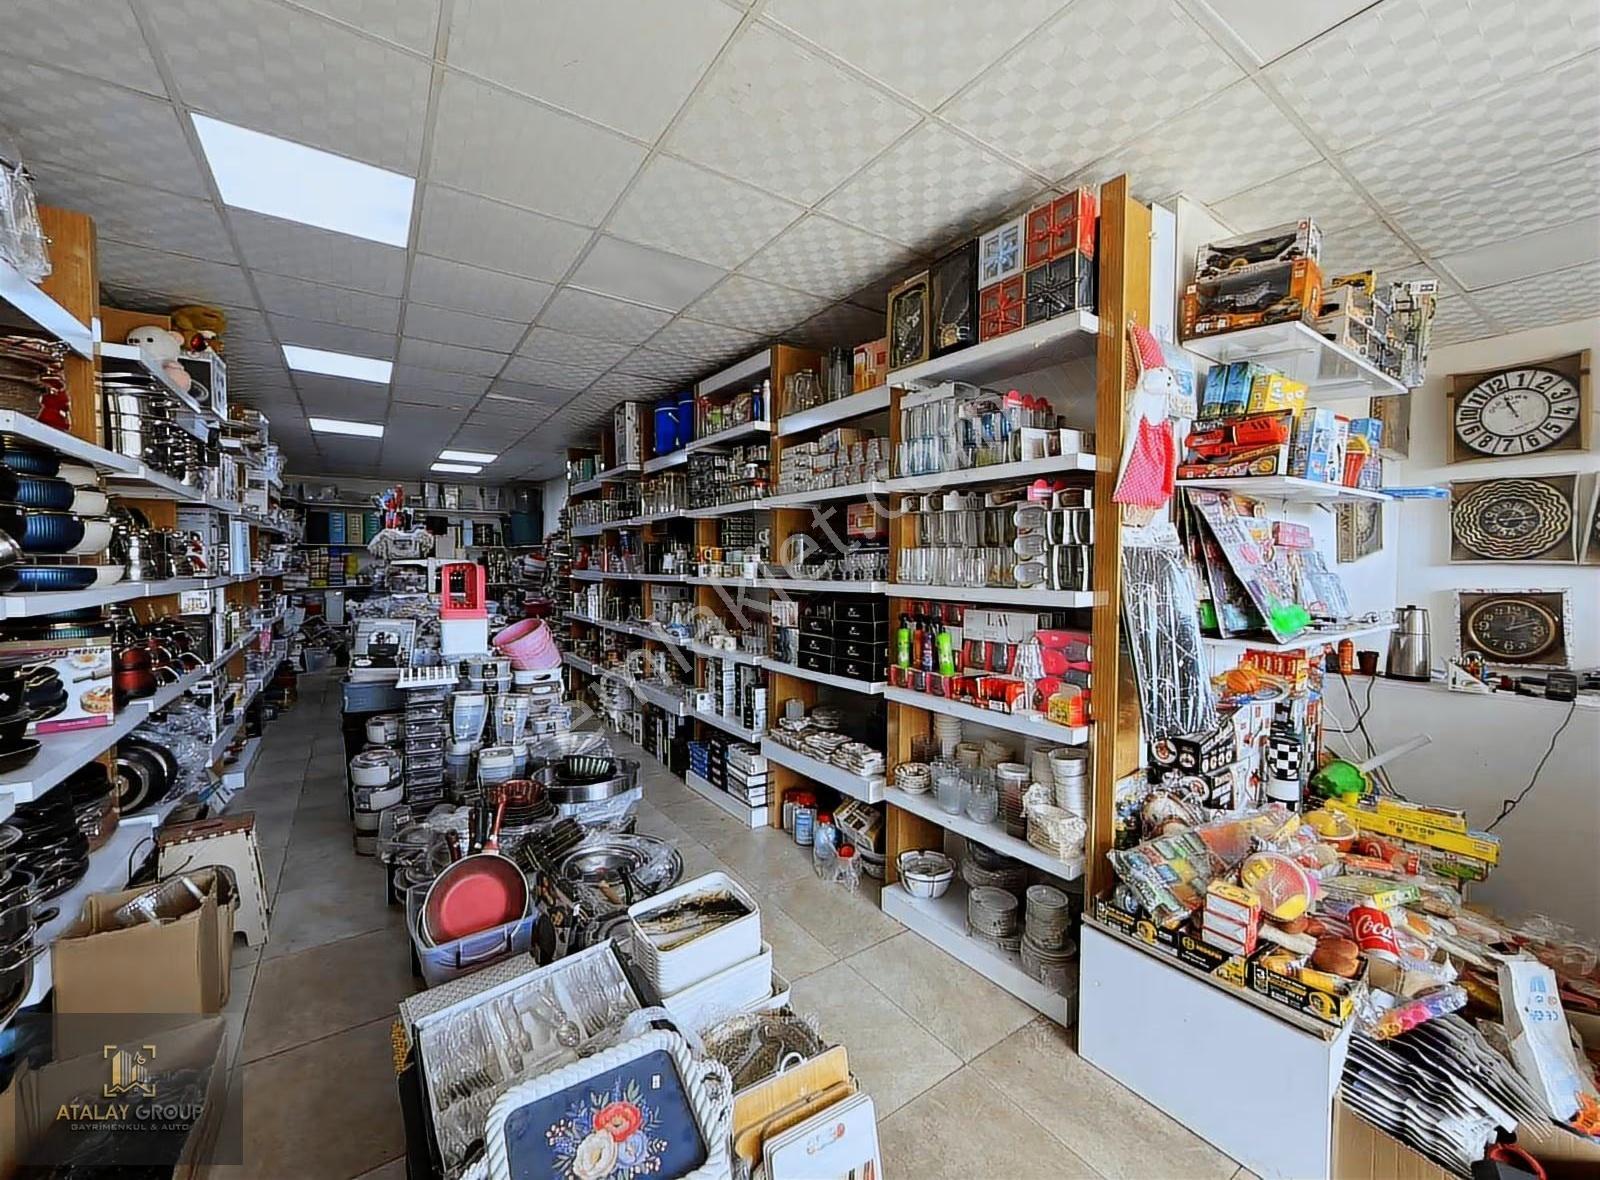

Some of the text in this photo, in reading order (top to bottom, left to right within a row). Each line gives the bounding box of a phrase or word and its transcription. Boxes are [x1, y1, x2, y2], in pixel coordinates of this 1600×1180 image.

[1517, 373, 1526, 386] 1
[1535, 375, 1553, 390] 2
[1484, 379, 1503, 394] 12
[1468, 392, 1489, 406] 11
[1551, 388, 1571, 400] 3
[1460, 408, 1478, 421] 10
[1554, 406, 1575, 415] 4
[1543, 422, 1562, 433] 5
[1478, 435, 1493, 448] 8
[1503, 439, 1514, 452] 7
[1527, 434, 1540, 448] 6
[1356, 915, 1393, 940] Coca
